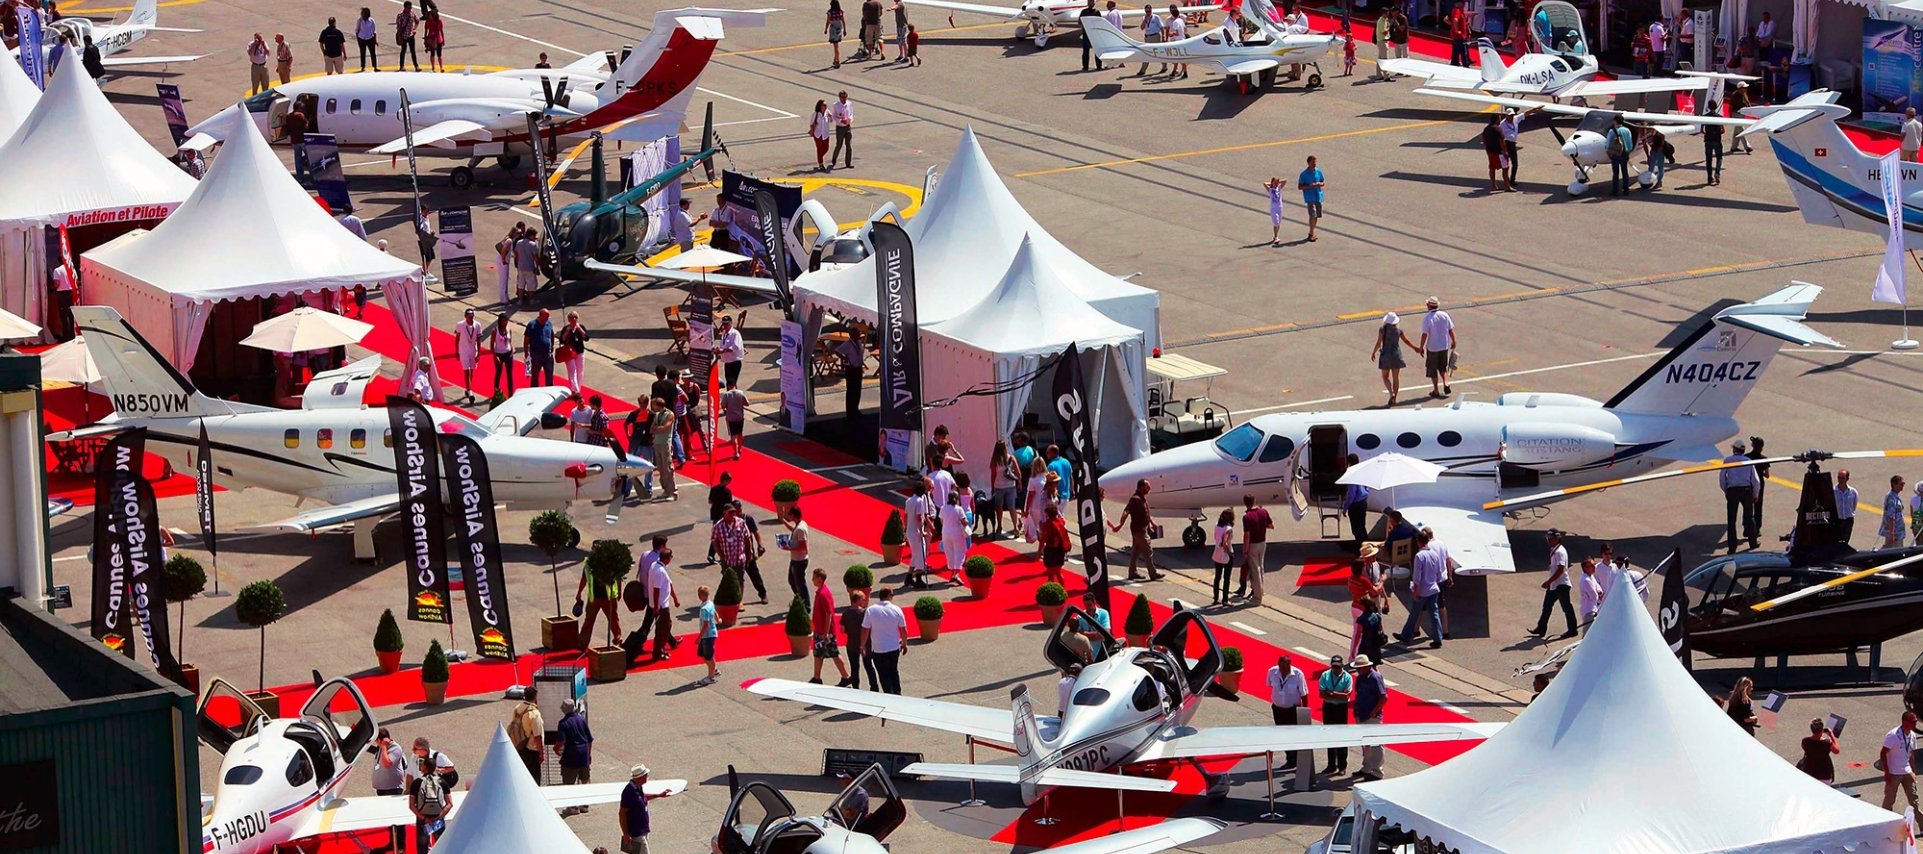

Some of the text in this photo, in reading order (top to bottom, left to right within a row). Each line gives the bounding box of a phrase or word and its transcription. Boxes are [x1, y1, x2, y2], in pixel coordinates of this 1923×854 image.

[106, 30, 133, 49] F-HCGM
[1520, 69, 1555, 84] OK-LSA
[66, 205, 169, 227] Aviation et Pilote
[1665, 361, 1761, 384] N404CZ
[114, 393, 189, 412] N850VM
[1517, 438, 1582, 447] CITATION
[105, 543, 124, 629] Cannes
[211, 810, 266, 850] F-HGDU
